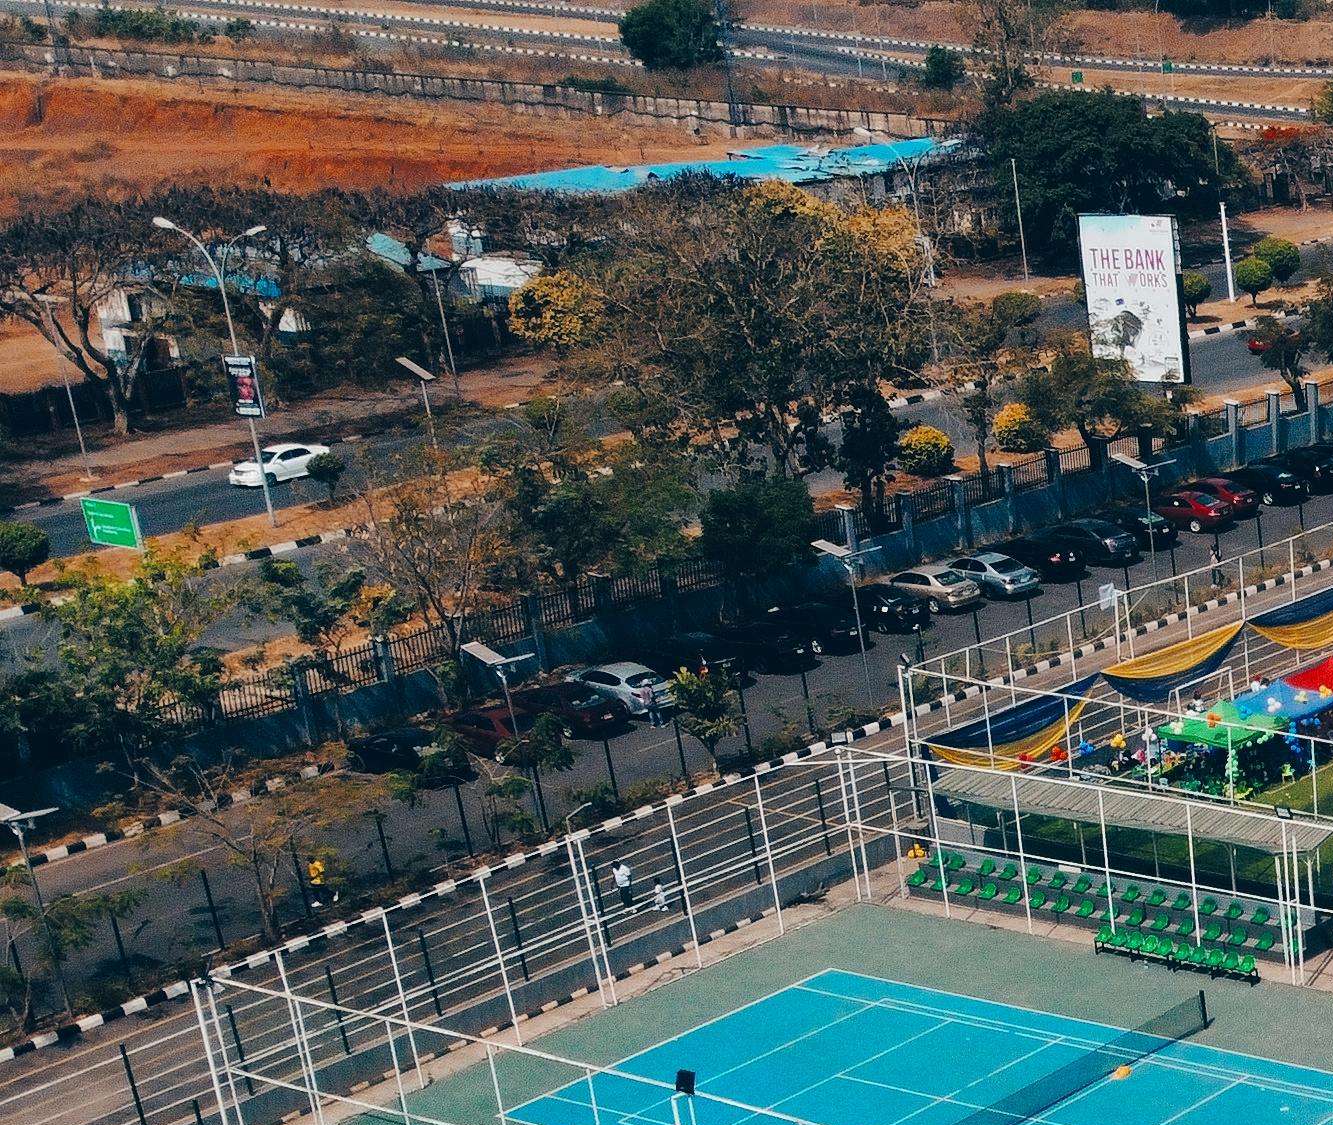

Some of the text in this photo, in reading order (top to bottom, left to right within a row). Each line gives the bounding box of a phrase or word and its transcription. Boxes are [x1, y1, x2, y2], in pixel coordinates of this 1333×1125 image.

[1089, 248, 1166, 271] THE BANK
[1092, 272, 1168, 288] THAT WORKS
